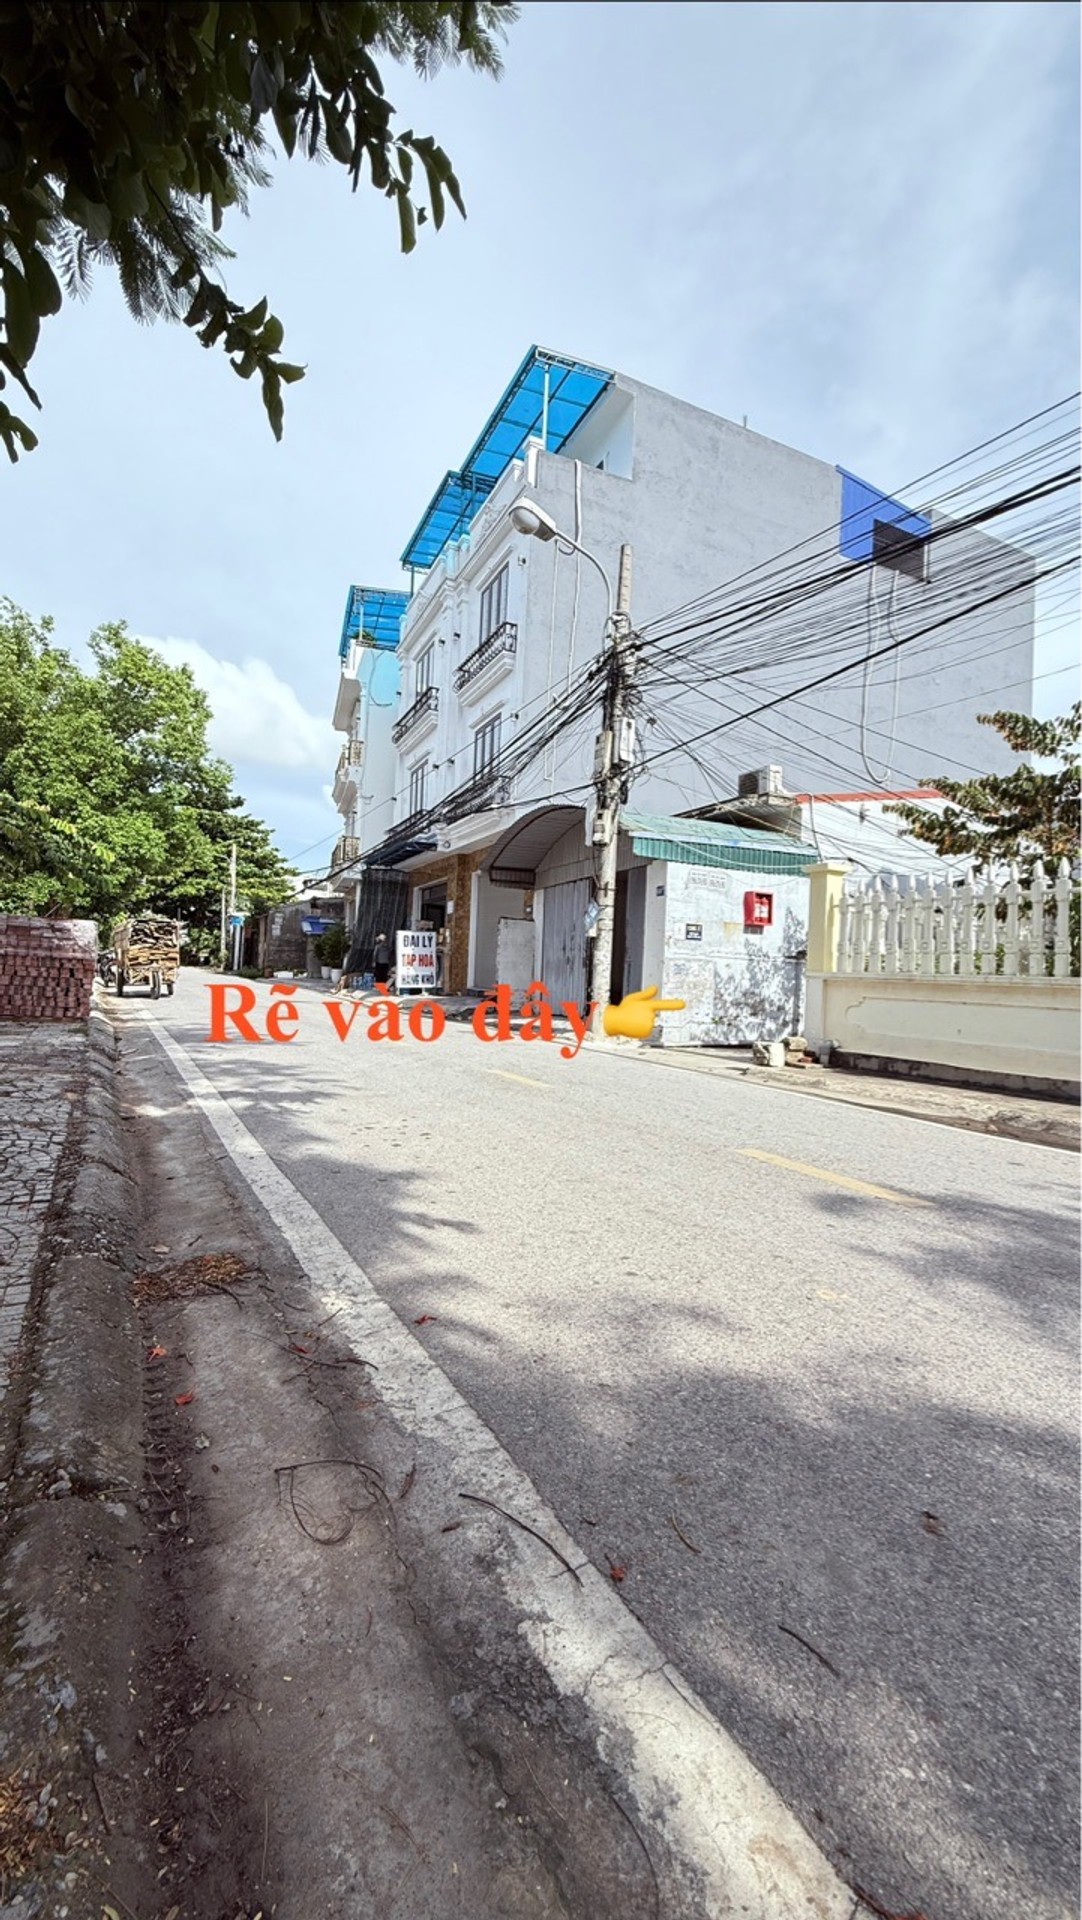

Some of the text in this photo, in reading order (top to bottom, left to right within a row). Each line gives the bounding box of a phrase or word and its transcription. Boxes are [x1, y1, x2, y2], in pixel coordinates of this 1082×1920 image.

[403, 932, 434, 950] ĐẠI LÝ
[402, 953, 417, 969] TẠP
